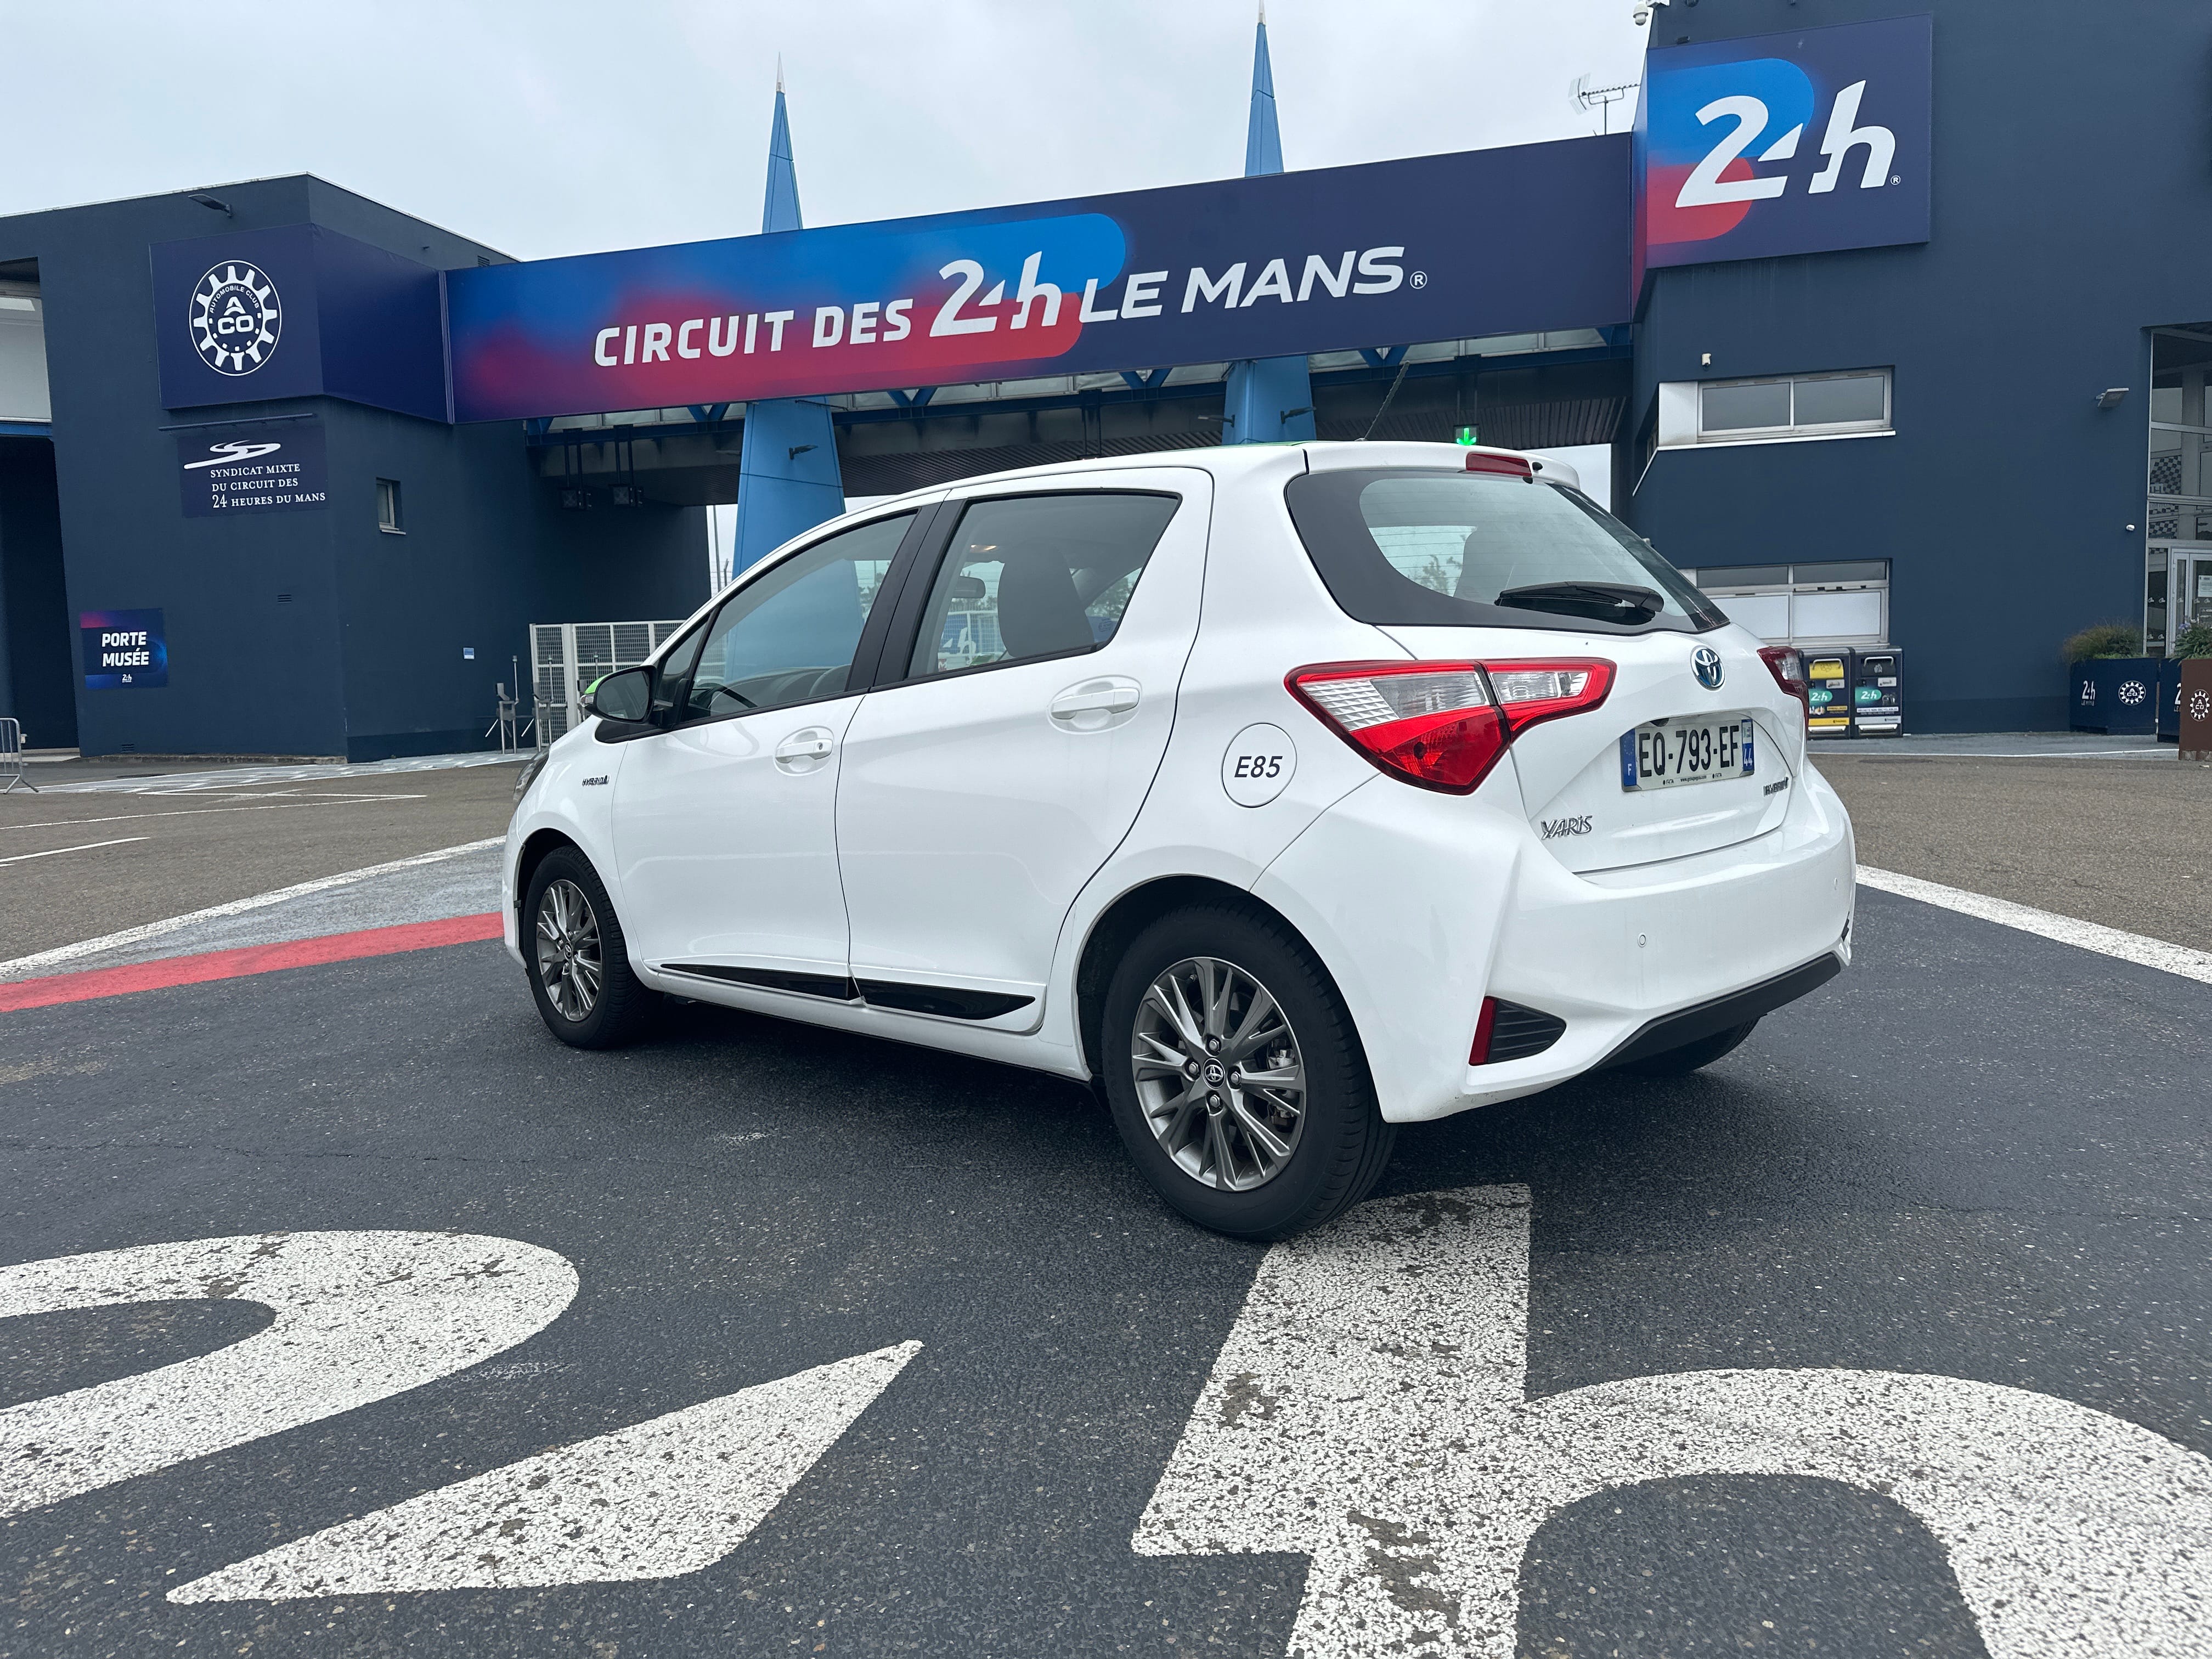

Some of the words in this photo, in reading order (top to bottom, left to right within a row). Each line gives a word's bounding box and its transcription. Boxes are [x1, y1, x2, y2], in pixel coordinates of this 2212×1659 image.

[1675, 80, 1896, 208] 24h
[209, 285, 245, 313] AUTOMOBILE
[246, 290, 259, 308] CLUB
[594, 310, 794, 367] CIRCUIT
[812, 298, 913, 348] DES
[929, 251, 1062, 337] 24h
[1079, 270, 1169, 323] LE
[1181, 246, 1404, 313] MANS
[210, 466, 263, 478] SYNDICAT
[266, 463, 301, 474] MIXTE
[212, 483, 227, 492] DU
[230, 479, 275, 490] CIRCUIT
[278, 478, 298, 487] DES
[212, 494, 227, 508] 24
[231, 496, 273, 506] HEURES
[276, 495, 291, 503] DU
[295, 493, 325, 503] MANS
[102, 631, 147, 647] PORTE
[103, 647, 149, 667] MUSÉE
[1639, 725, 1739, 777] EQ-793-EF
[1743, 748, 1753, 766] 44
[1234, 755, 1283, 777] E85
[1628, 763, 1632, 776] F
